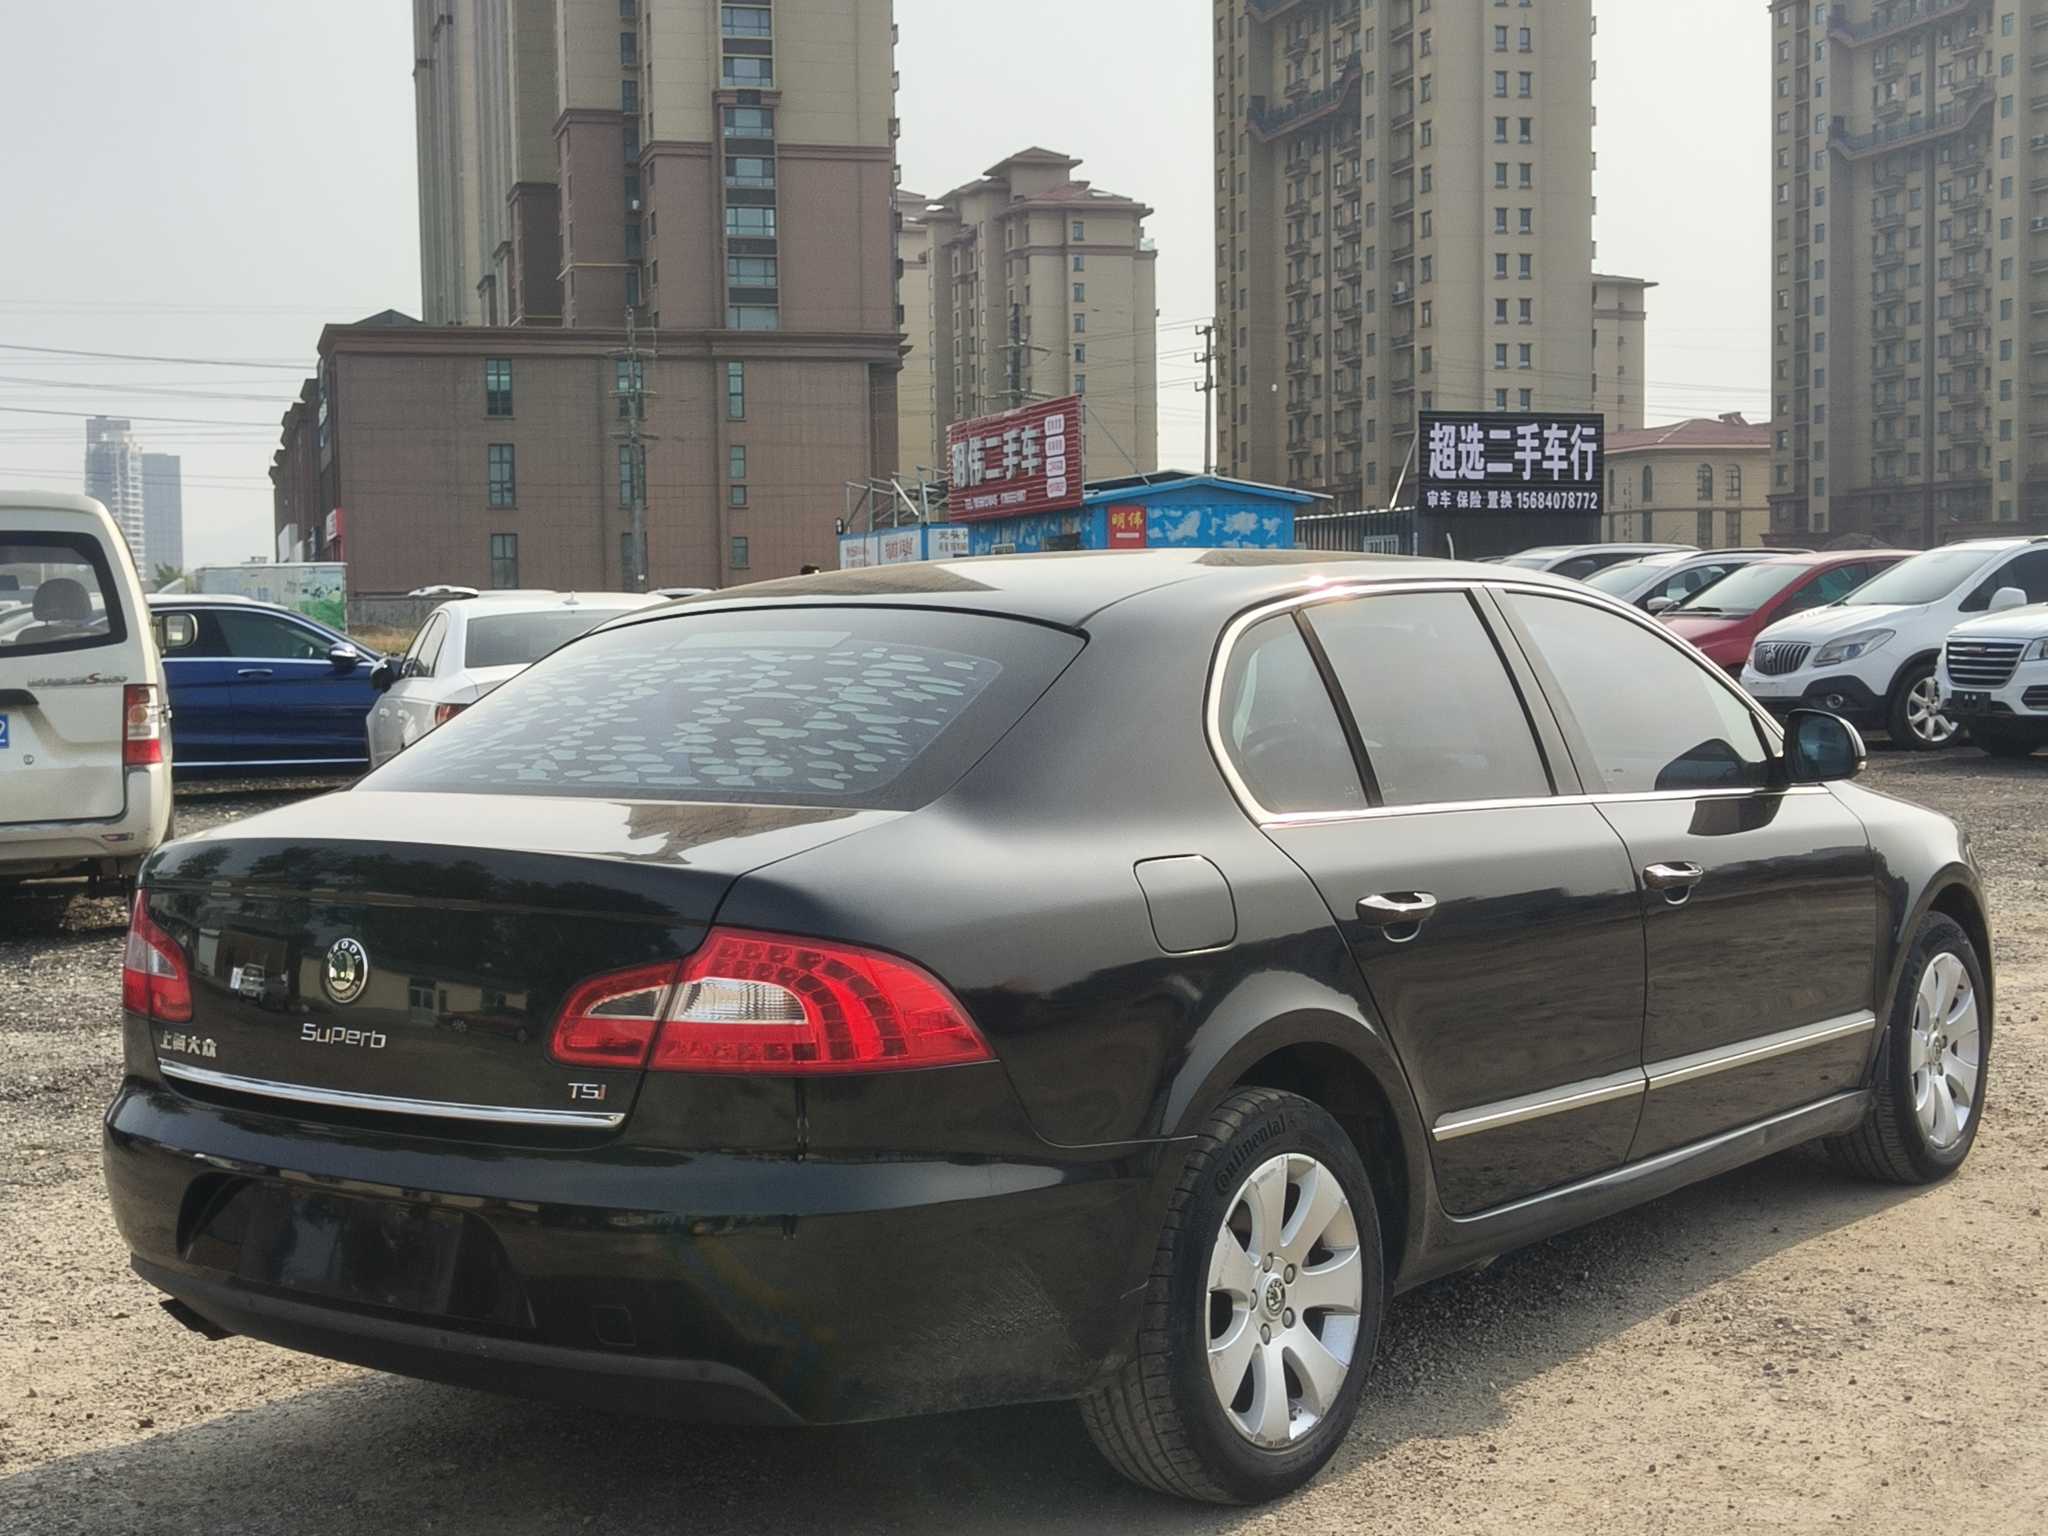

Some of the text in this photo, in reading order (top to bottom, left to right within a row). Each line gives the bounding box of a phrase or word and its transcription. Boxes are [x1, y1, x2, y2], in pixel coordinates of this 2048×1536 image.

[1428, 422, 1598, 481] 超选二手车行
[1426, 490, 1598, 510] 审车 保险 置换 15684078772
